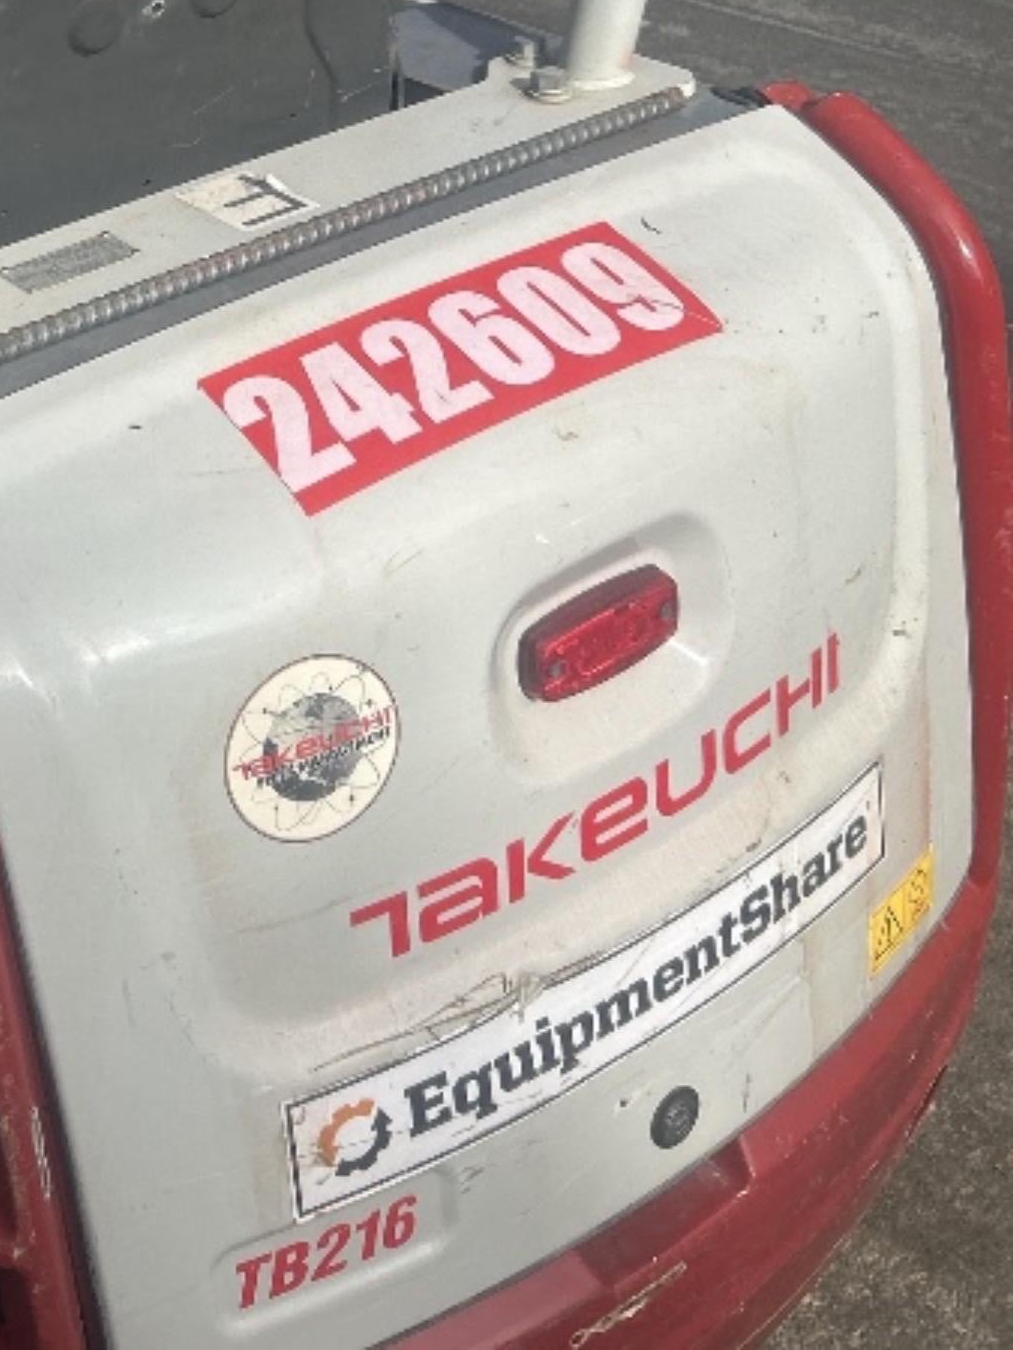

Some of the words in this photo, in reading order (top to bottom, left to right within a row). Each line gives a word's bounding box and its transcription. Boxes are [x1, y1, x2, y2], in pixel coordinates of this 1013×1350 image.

[222, 242, 685, 493] 242609
[348, 631, 840, 958] TAKEUCHI
[403, 813, 868, 1137] EquipmentShare
[235, 1193, 417, 1309] TB216
